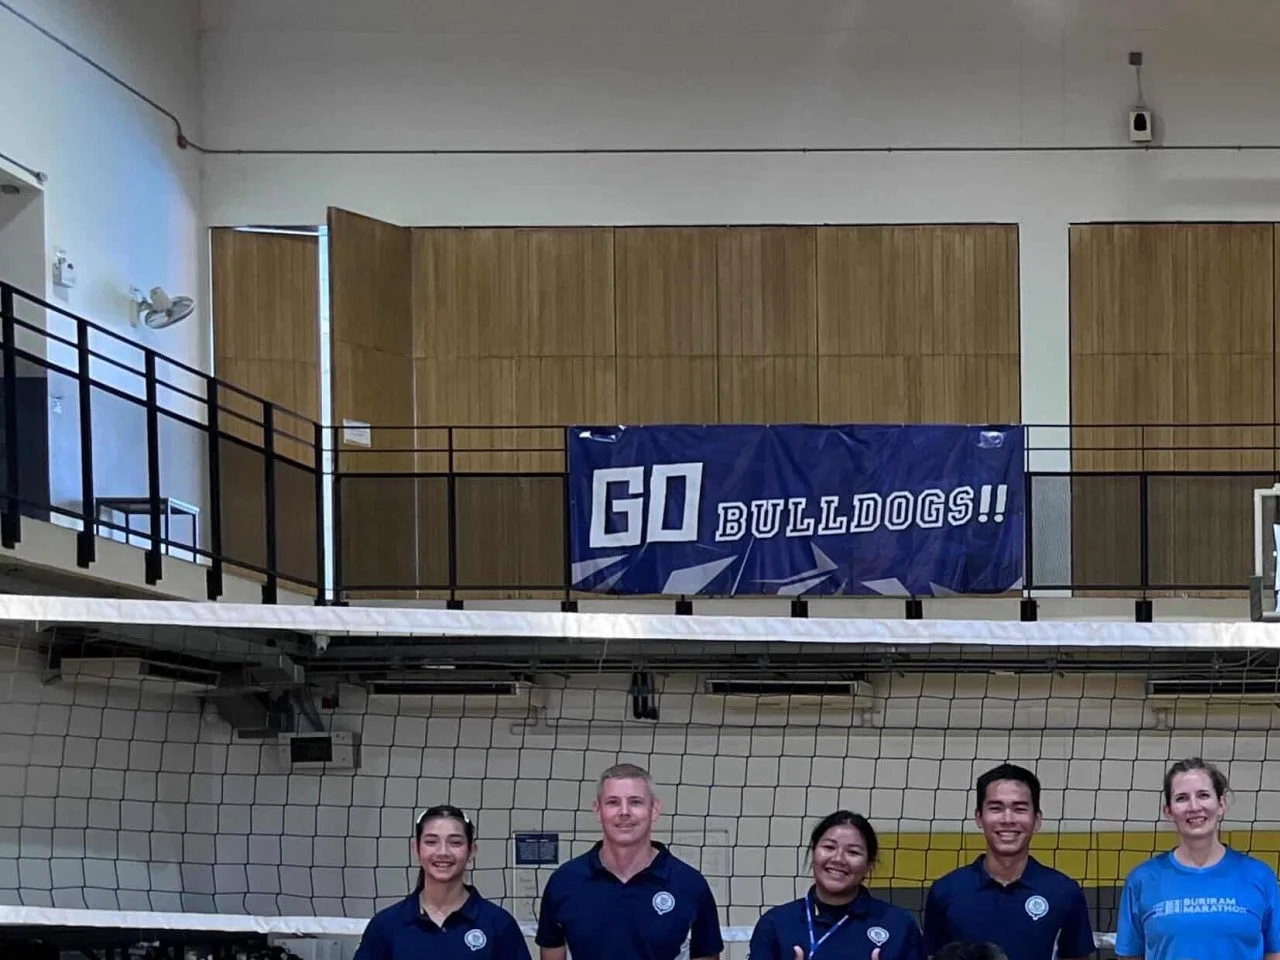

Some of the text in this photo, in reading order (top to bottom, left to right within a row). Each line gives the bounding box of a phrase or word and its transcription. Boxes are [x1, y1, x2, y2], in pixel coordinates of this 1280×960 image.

[589, 462, 1008, 548] GO BULLDOGS!!
[1183, 897, 1236, 905] BURIRAM
